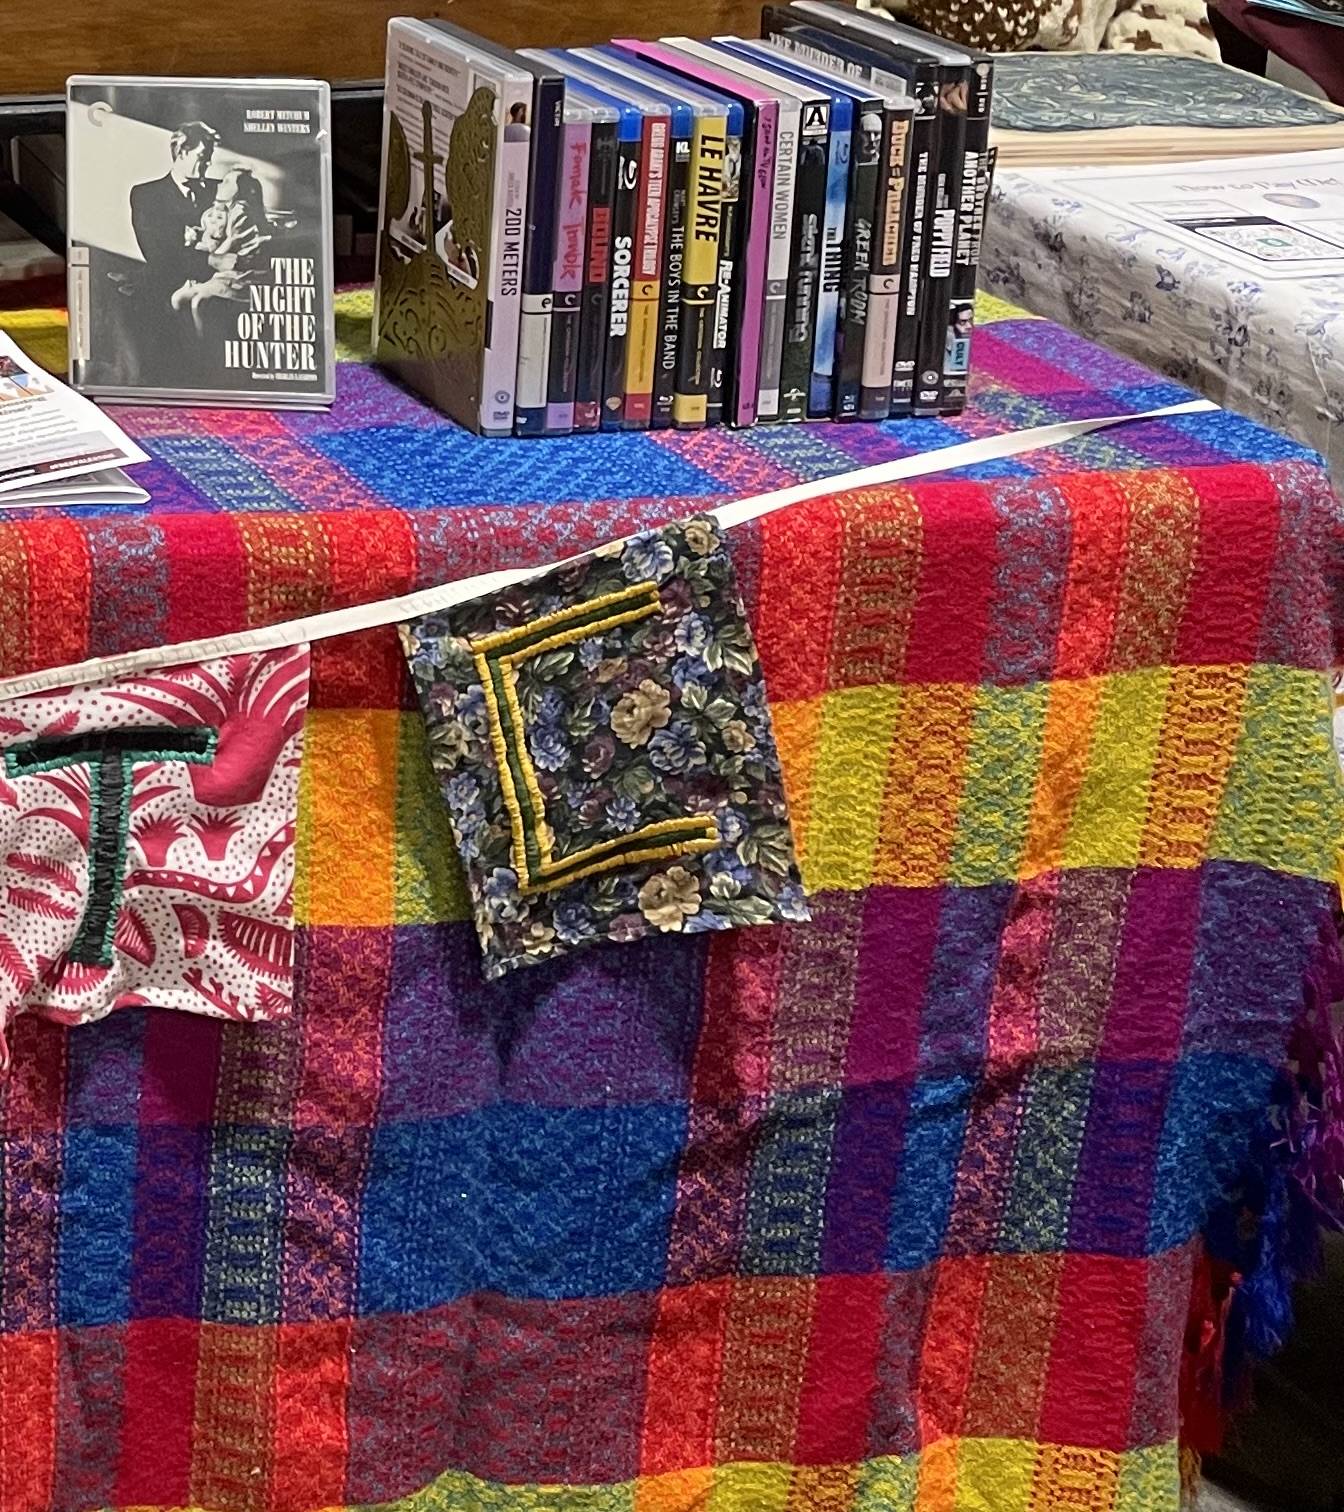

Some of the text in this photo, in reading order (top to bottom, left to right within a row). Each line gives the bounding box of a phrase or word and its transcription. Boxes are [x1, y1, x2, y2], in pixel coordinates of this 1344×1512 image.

[768, 31, 863, 78] THE MURDER OF
[889, 120, 909, 167] BUCK
[694, 134, 724, 244] LE HAVRE
[771, 130, 795, 241] CERTAIN WOMEN
[955, 150, 979, 266] ANOTHER PLANET
[505, 207, 522, 243] 200
[270, 257, 315, 286] THE
[501, 245, 521, 298] METERS
[609, 235, 633, 338] SORCERER
[849, 217, 873, 326] GREEN ROOM
[928, 247, 953, 279] FIELD
[248, 284, 316, 313] NIGHT
[662, 225, 685, 370] THE BOYS IN THE BAND
[715, 259, 733, 350] RE-ANIMATOR
[236, 312, 316, 342] OF THE
[223, 340, 318, 371] HUNTER
[955, 341, 965, 367] CULT
